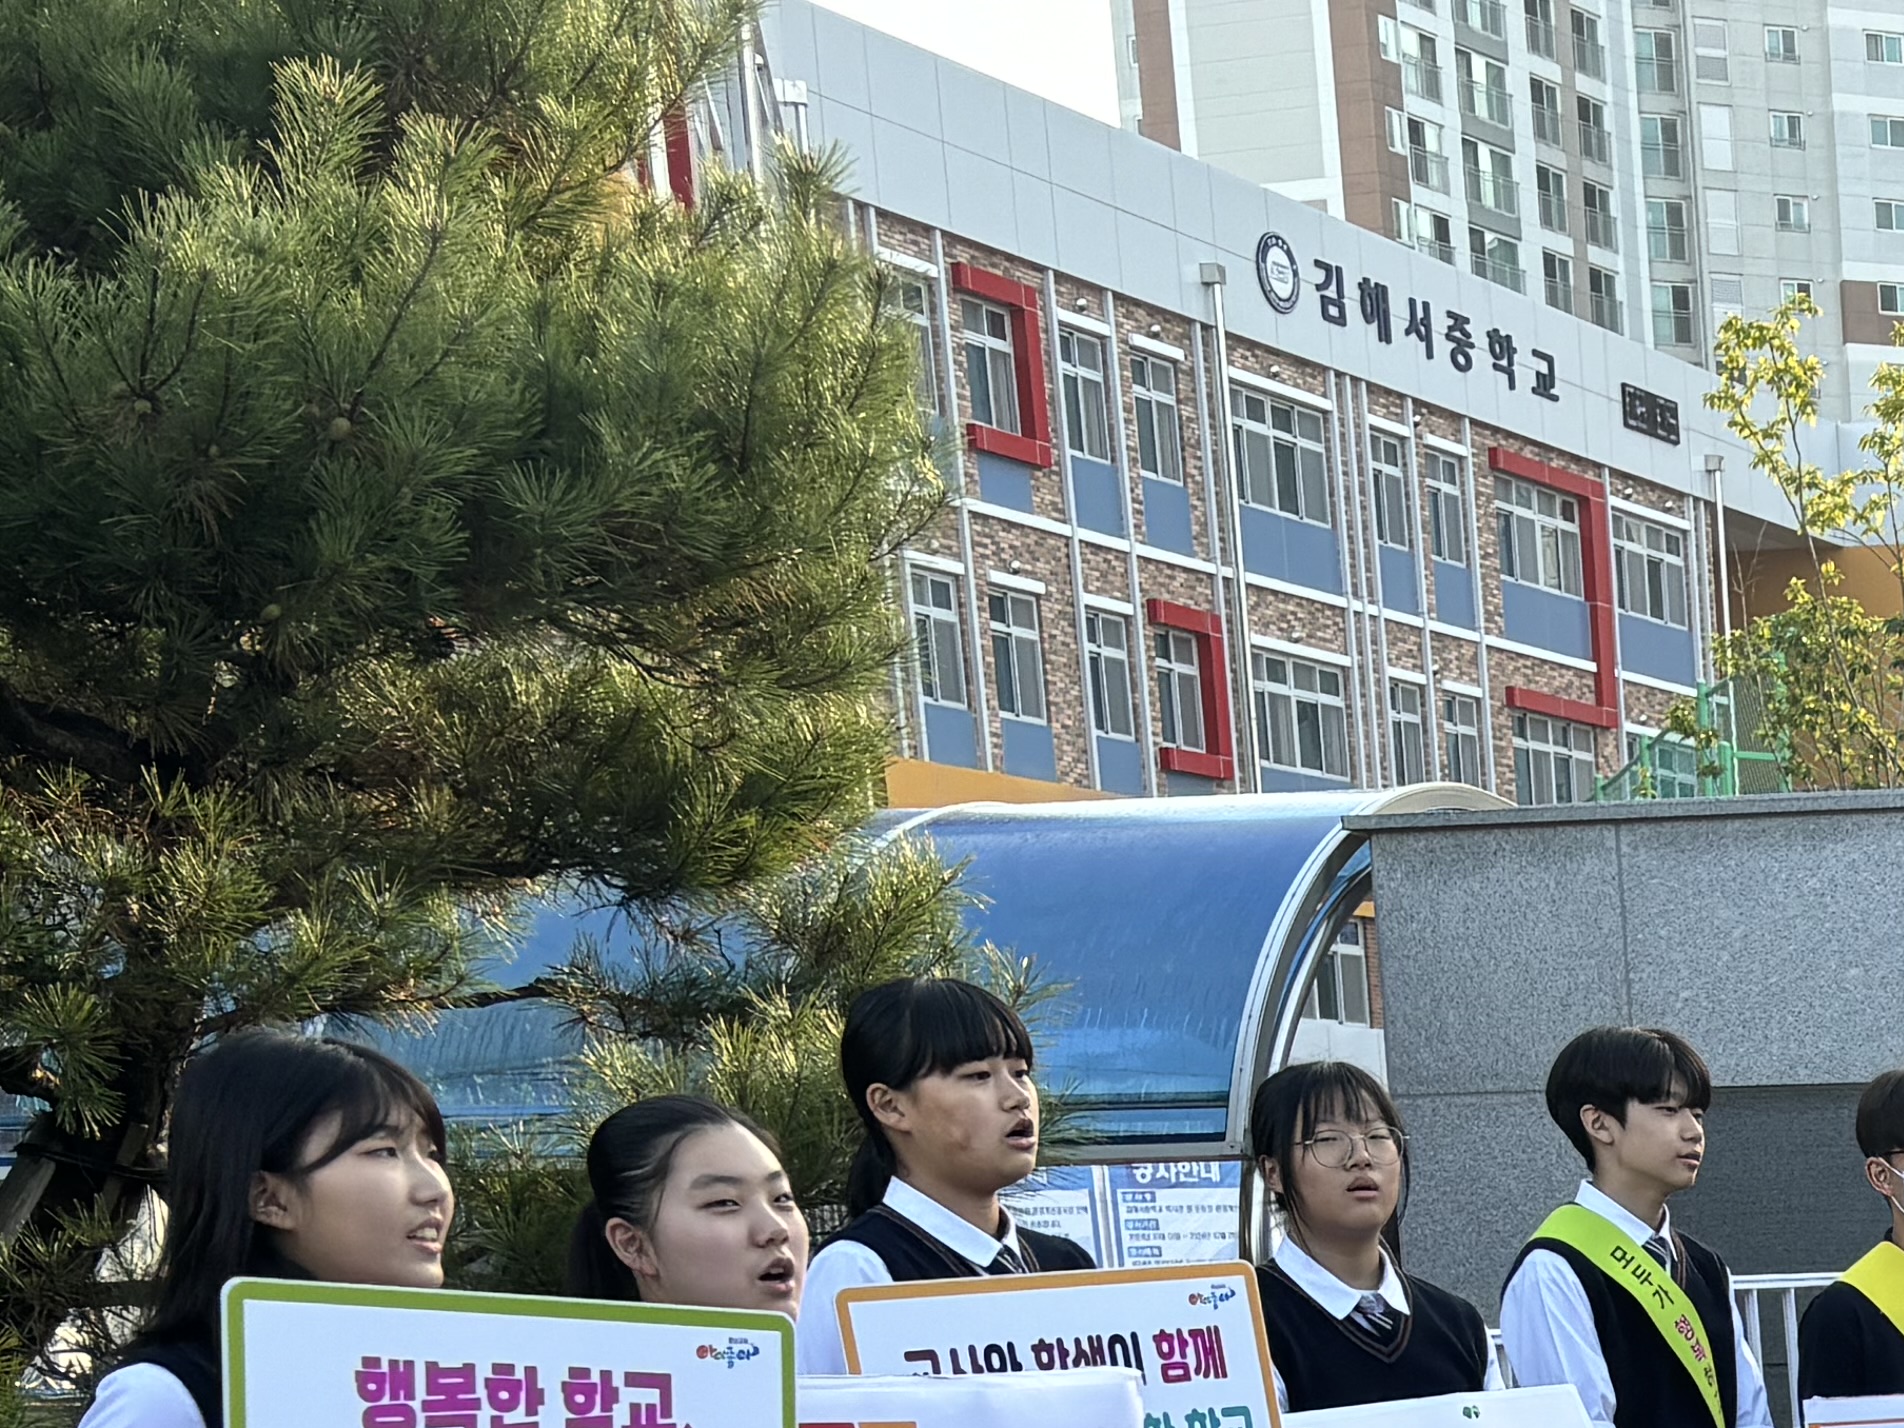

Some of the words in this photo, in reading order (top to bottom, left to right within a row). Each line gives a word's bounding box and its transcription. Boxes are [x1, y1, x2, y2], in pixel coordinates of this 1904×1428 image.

[1313, 258, 1560, 402] 김해서중학교
[1609, 1245, 1675, 1310] 모두가
[1152, 1325, 1228, 1384] 함께
